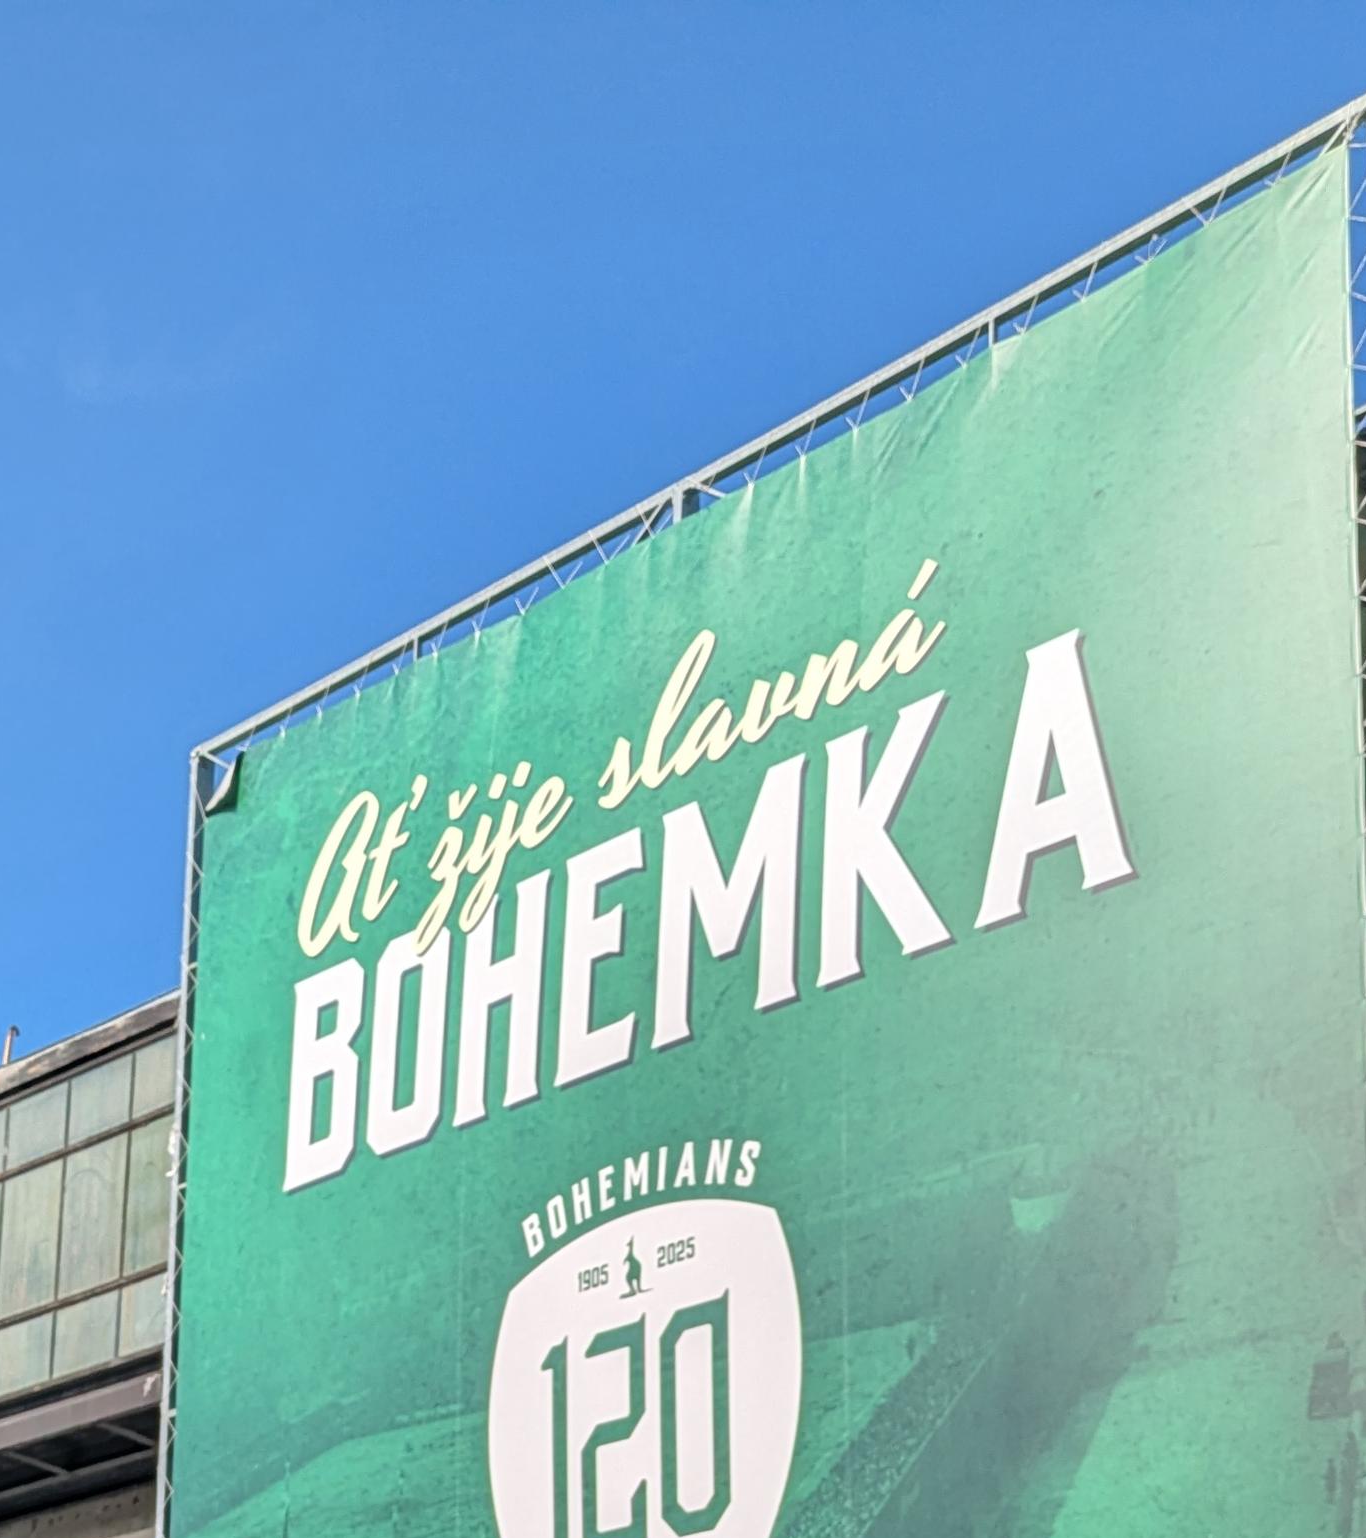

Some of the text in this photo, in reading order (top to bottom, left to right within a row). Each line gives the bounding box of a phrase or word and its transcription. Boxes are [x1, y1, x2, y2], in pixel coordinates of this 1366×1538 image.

[295, 558, 947, 958] Ať žije slavná
[281, 628, 1137, 1192] BOHEMKA
[521, 1138, 762, 1259] BOHEMIANS
[577, 1236, 696, 1293] 1905 2025
